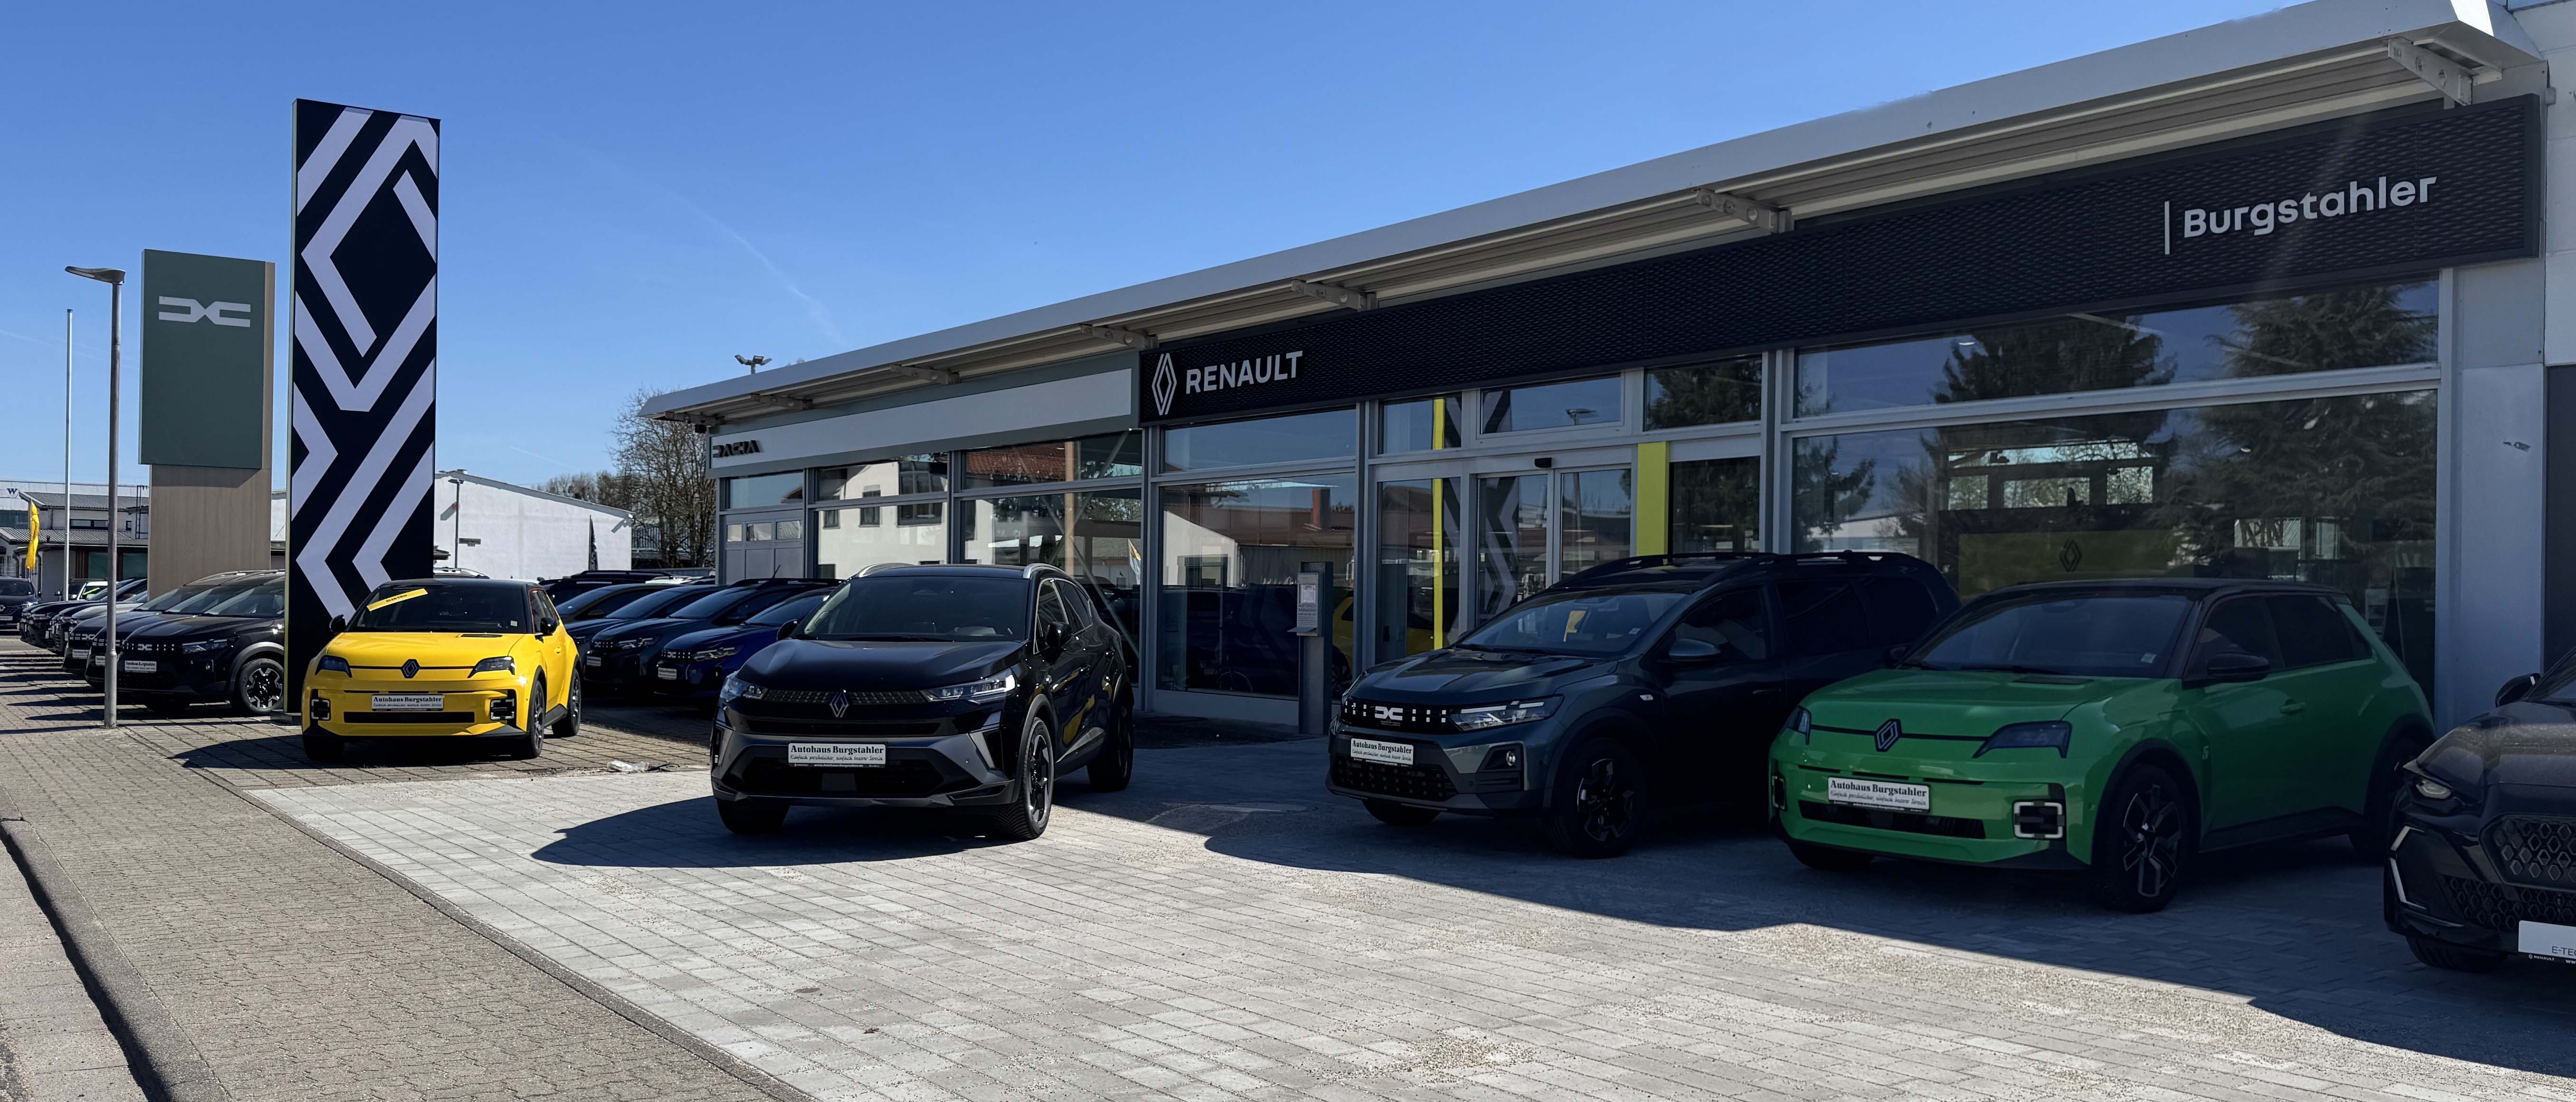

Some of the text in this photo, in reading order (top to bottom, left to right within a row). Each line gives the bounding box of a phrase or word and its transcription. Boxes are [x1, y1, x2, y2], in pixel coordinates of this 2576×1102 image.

[2184, 176, 2437, 238] Burgstahler
[1186, 351, 1303, 394] RENAULT
[712, 440, 762, 458] DACIA
[791, 745, 884, 755] Autohaus Burgstahler
[1352, 740, 1412, 754] Autohaus Burgstahler
[2202, 746, 2209, 760] 5
[1831, 780, 1927, 797] Autohaus Burgstahler
